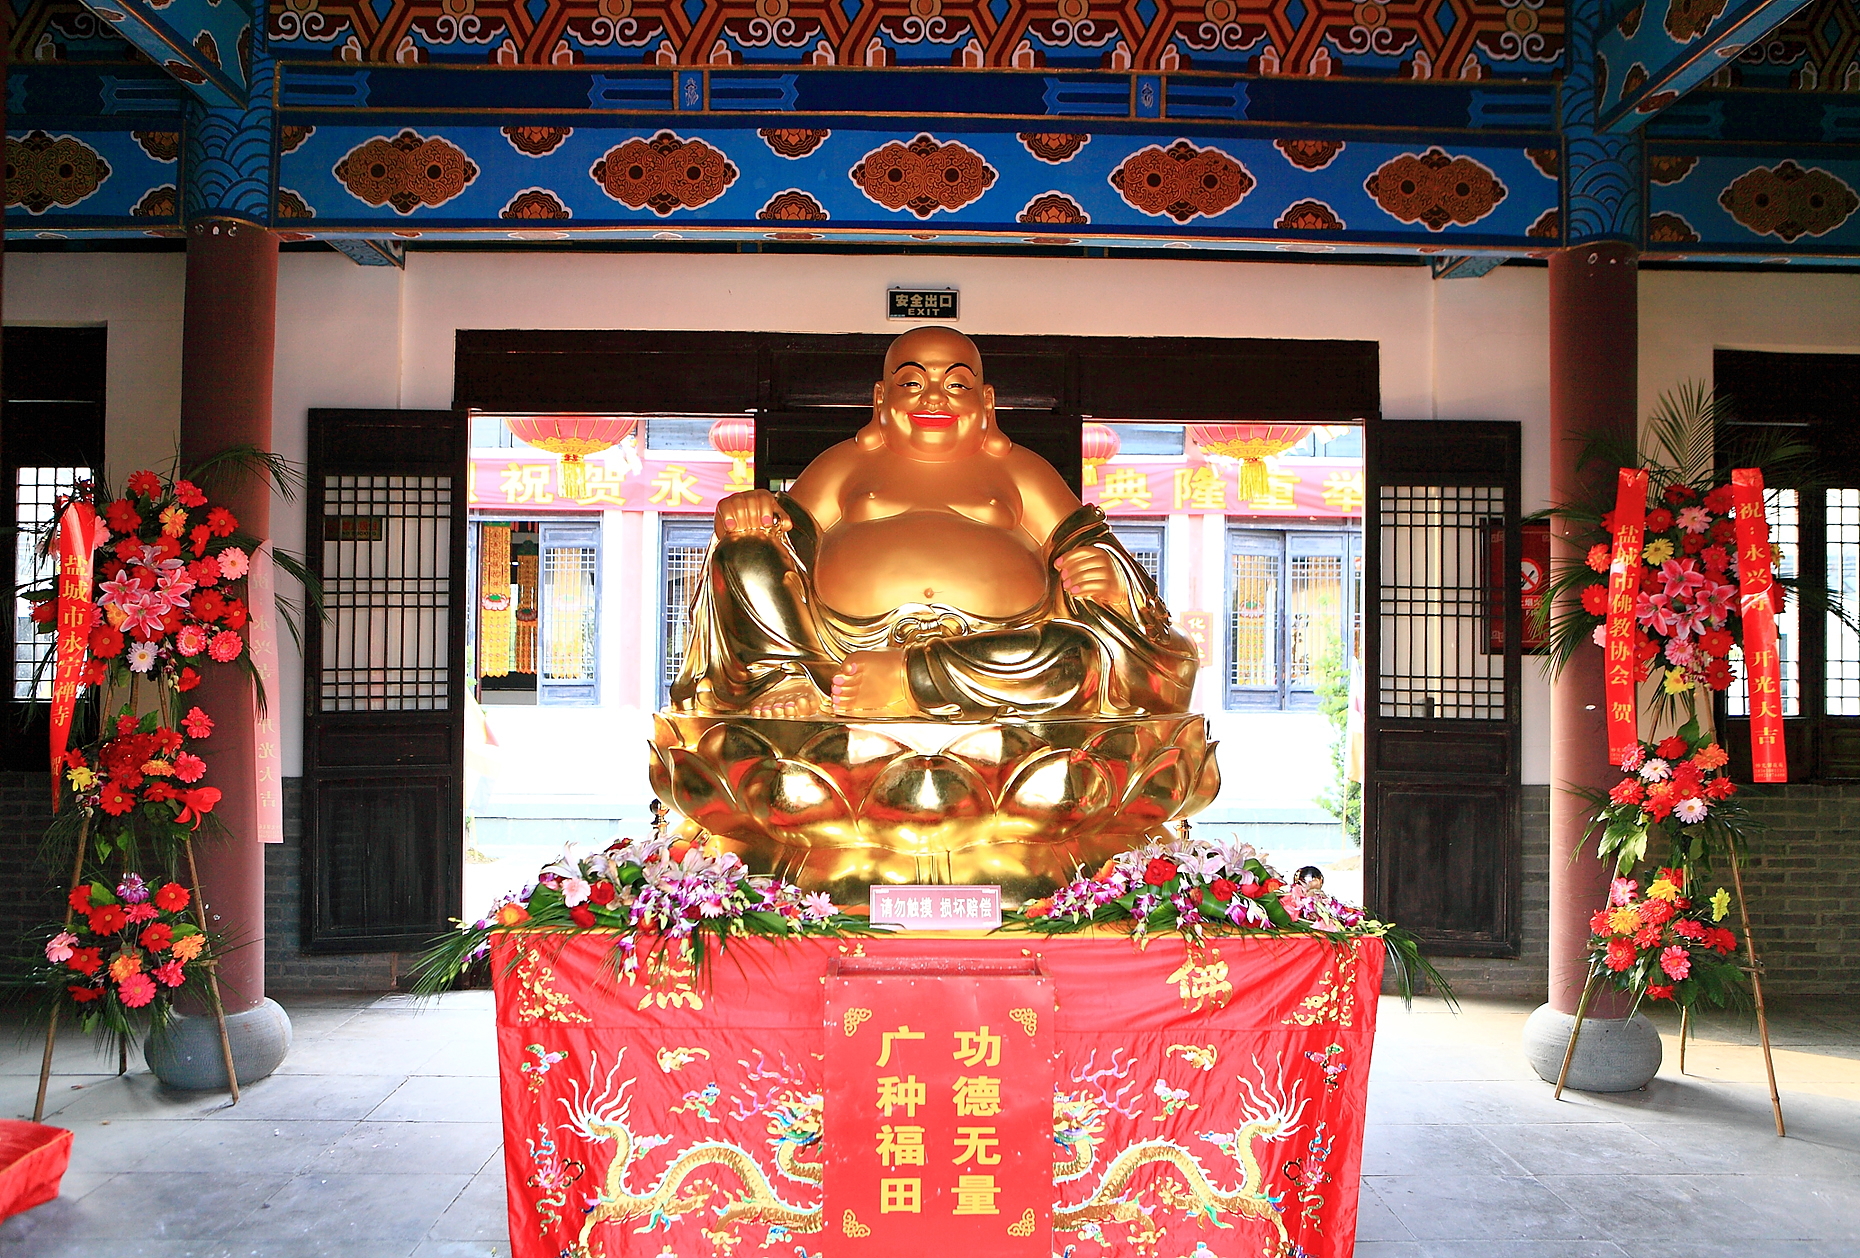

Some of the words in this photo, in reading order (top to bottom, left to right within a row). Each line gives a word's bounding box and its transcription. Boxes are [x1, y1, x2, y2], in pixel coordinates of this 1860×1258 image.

[895, 294, 952, 308] 安全出口
[907, 308, 940, 316] EXIT
[52, 555, 89, 727] 盐城市永宁禅寺
[1609, 525, 1639, 685] 盐城市佛教协会
[1611, 702, 1632, 723] 贺
[1750, 650, 1778, 745] 开光大吉
[880, 897, 933, 918] 请勿触摸
[939, 897, 993, 918] 损坏赔偿
[876, 1025, 926, 1214] 广种福田
[950, 1025, 1002, 1216] 功德无量
